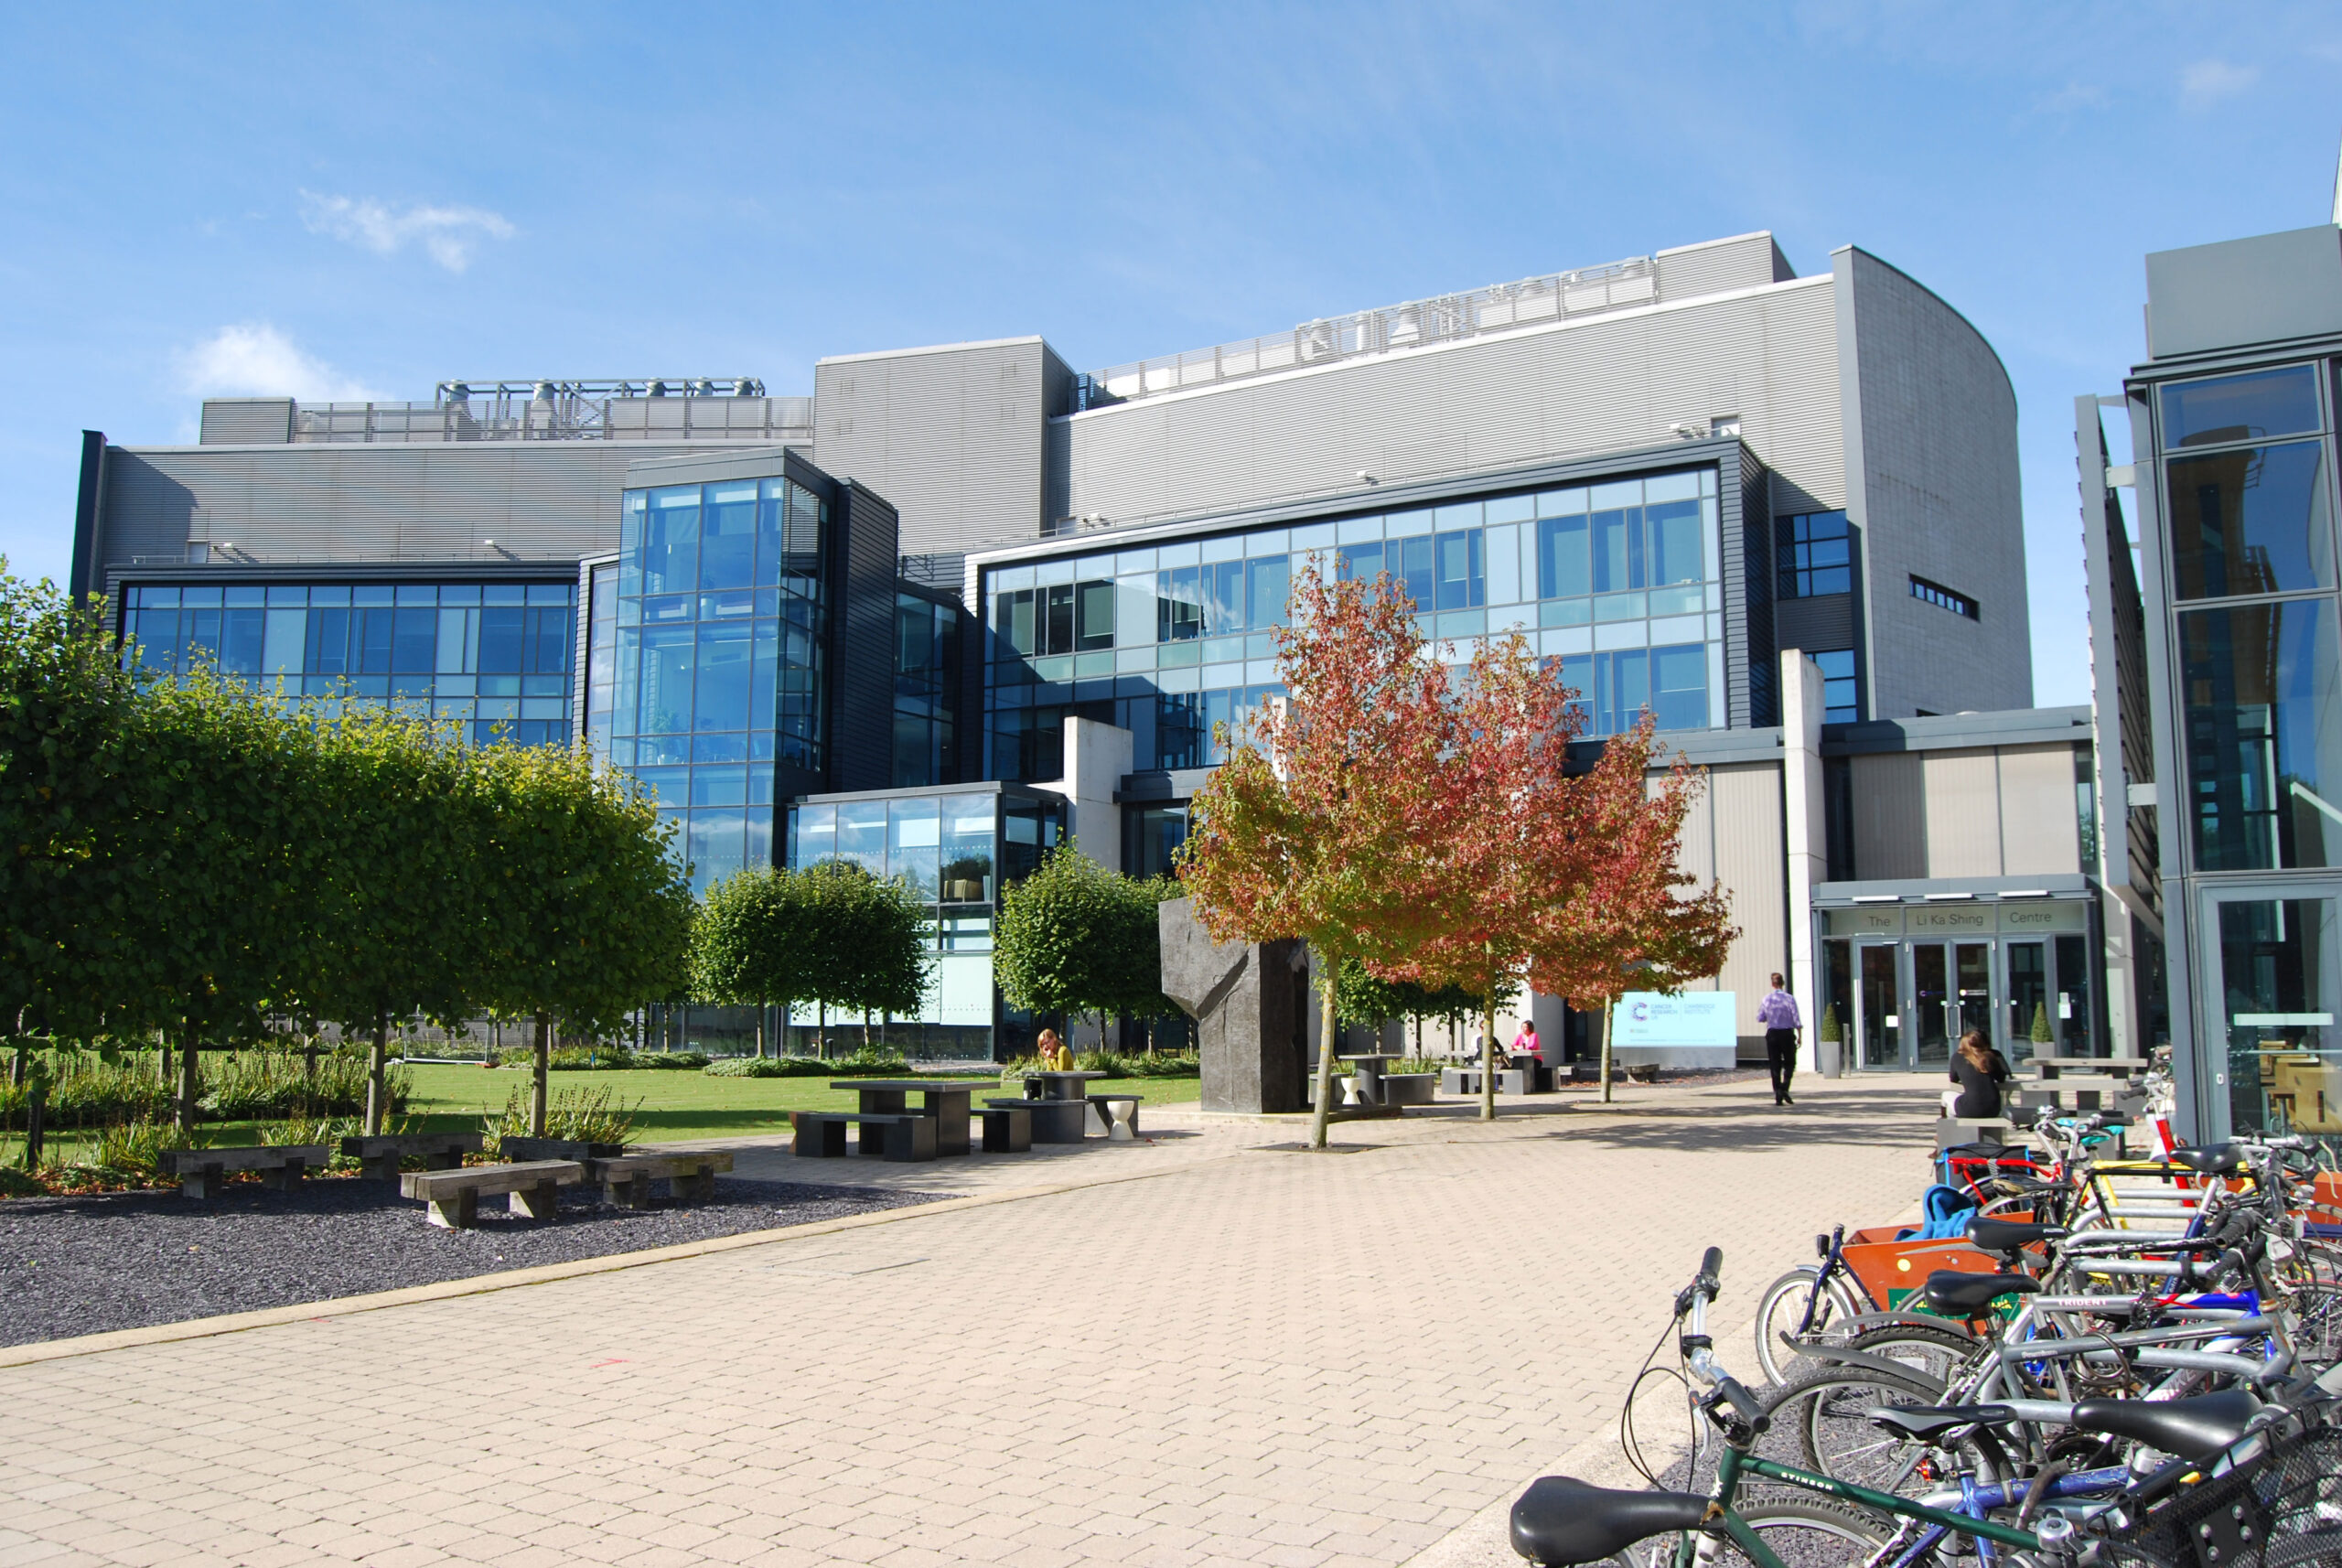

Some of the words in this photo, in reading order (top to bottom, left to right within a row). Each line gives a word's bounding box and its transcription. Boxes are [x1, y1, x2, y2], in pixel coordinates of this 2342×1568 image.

[1870, 916, 1891, 927] The
[1917, 917, 1927, 926] Li
[1931, 915, 1945, 926] Ka
[1950, 913, 1984, 926] Shing
[2010, 911, 2052, 923] Centre
[1780, 1471, 1833, 1491] STINSON
